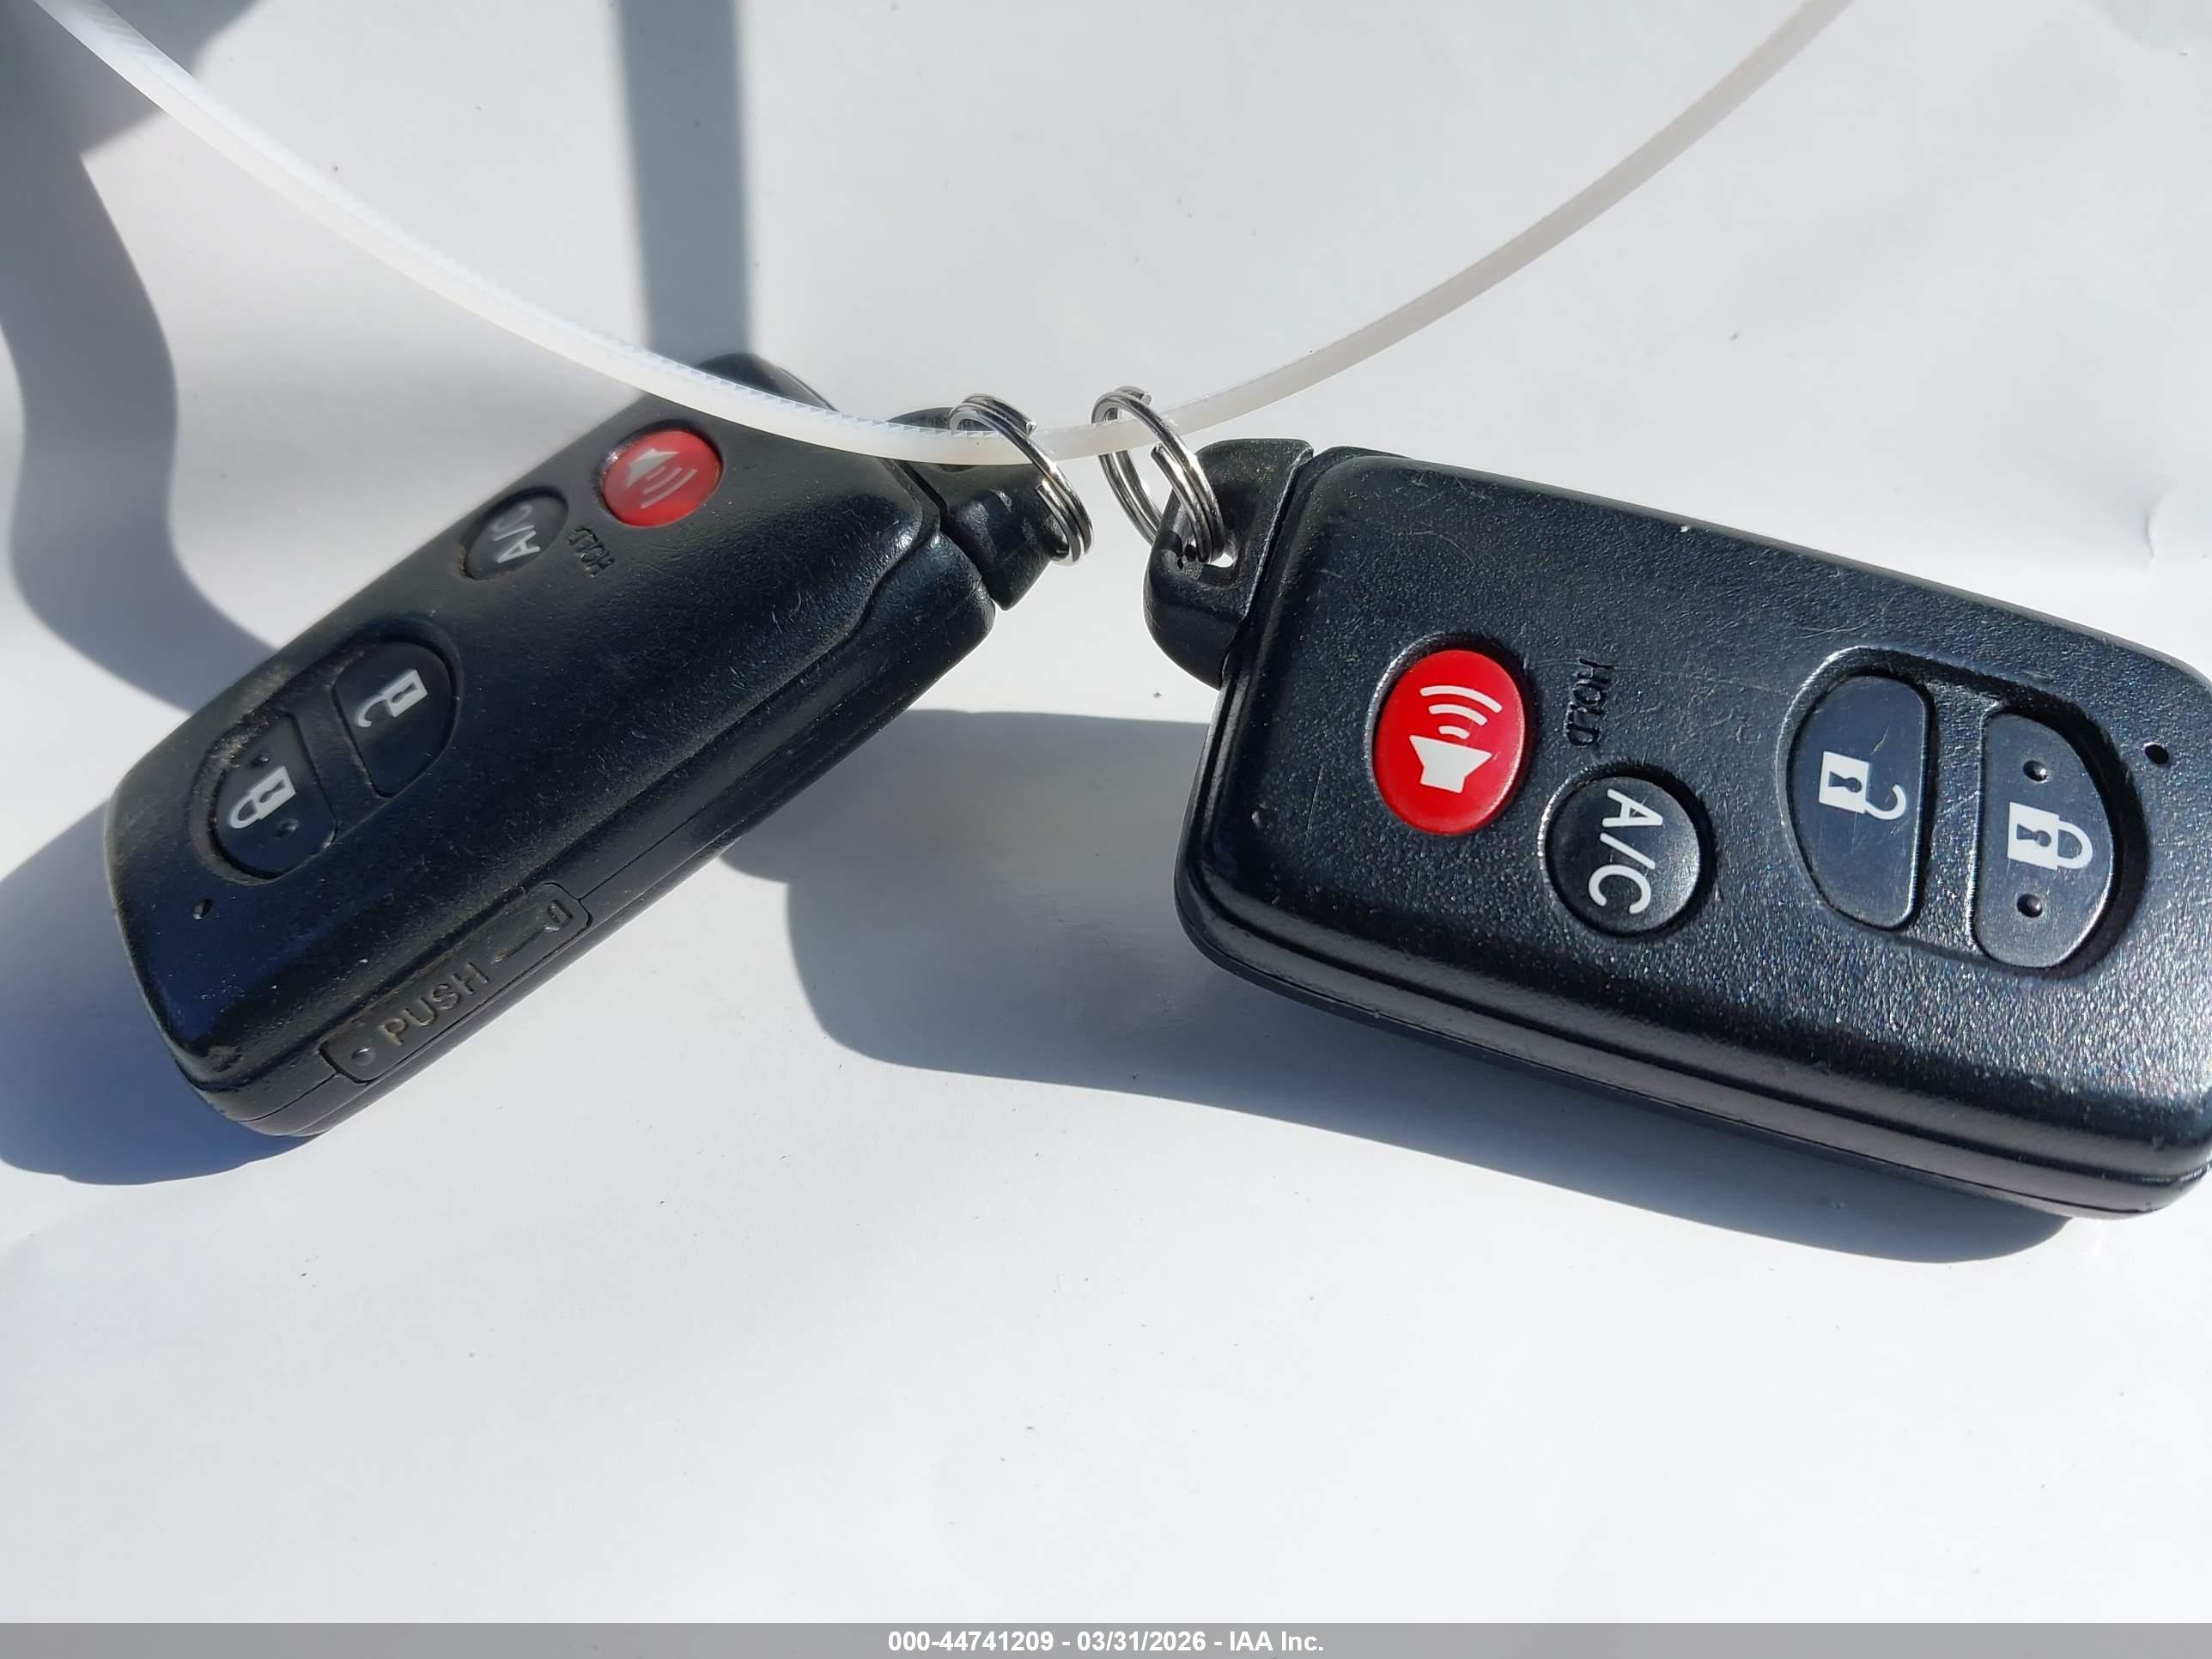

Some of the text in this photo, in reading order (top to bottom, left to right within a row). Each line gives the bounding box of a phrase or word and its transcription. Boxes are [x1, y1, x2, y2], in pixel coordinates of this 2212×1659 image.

[491, 505, 541, 563] A/C
[1564, 658, 1613, 748] HOLD
[1588, 788, 1663, 915] A/C
[381, 962, 489, 1046] PUSH
